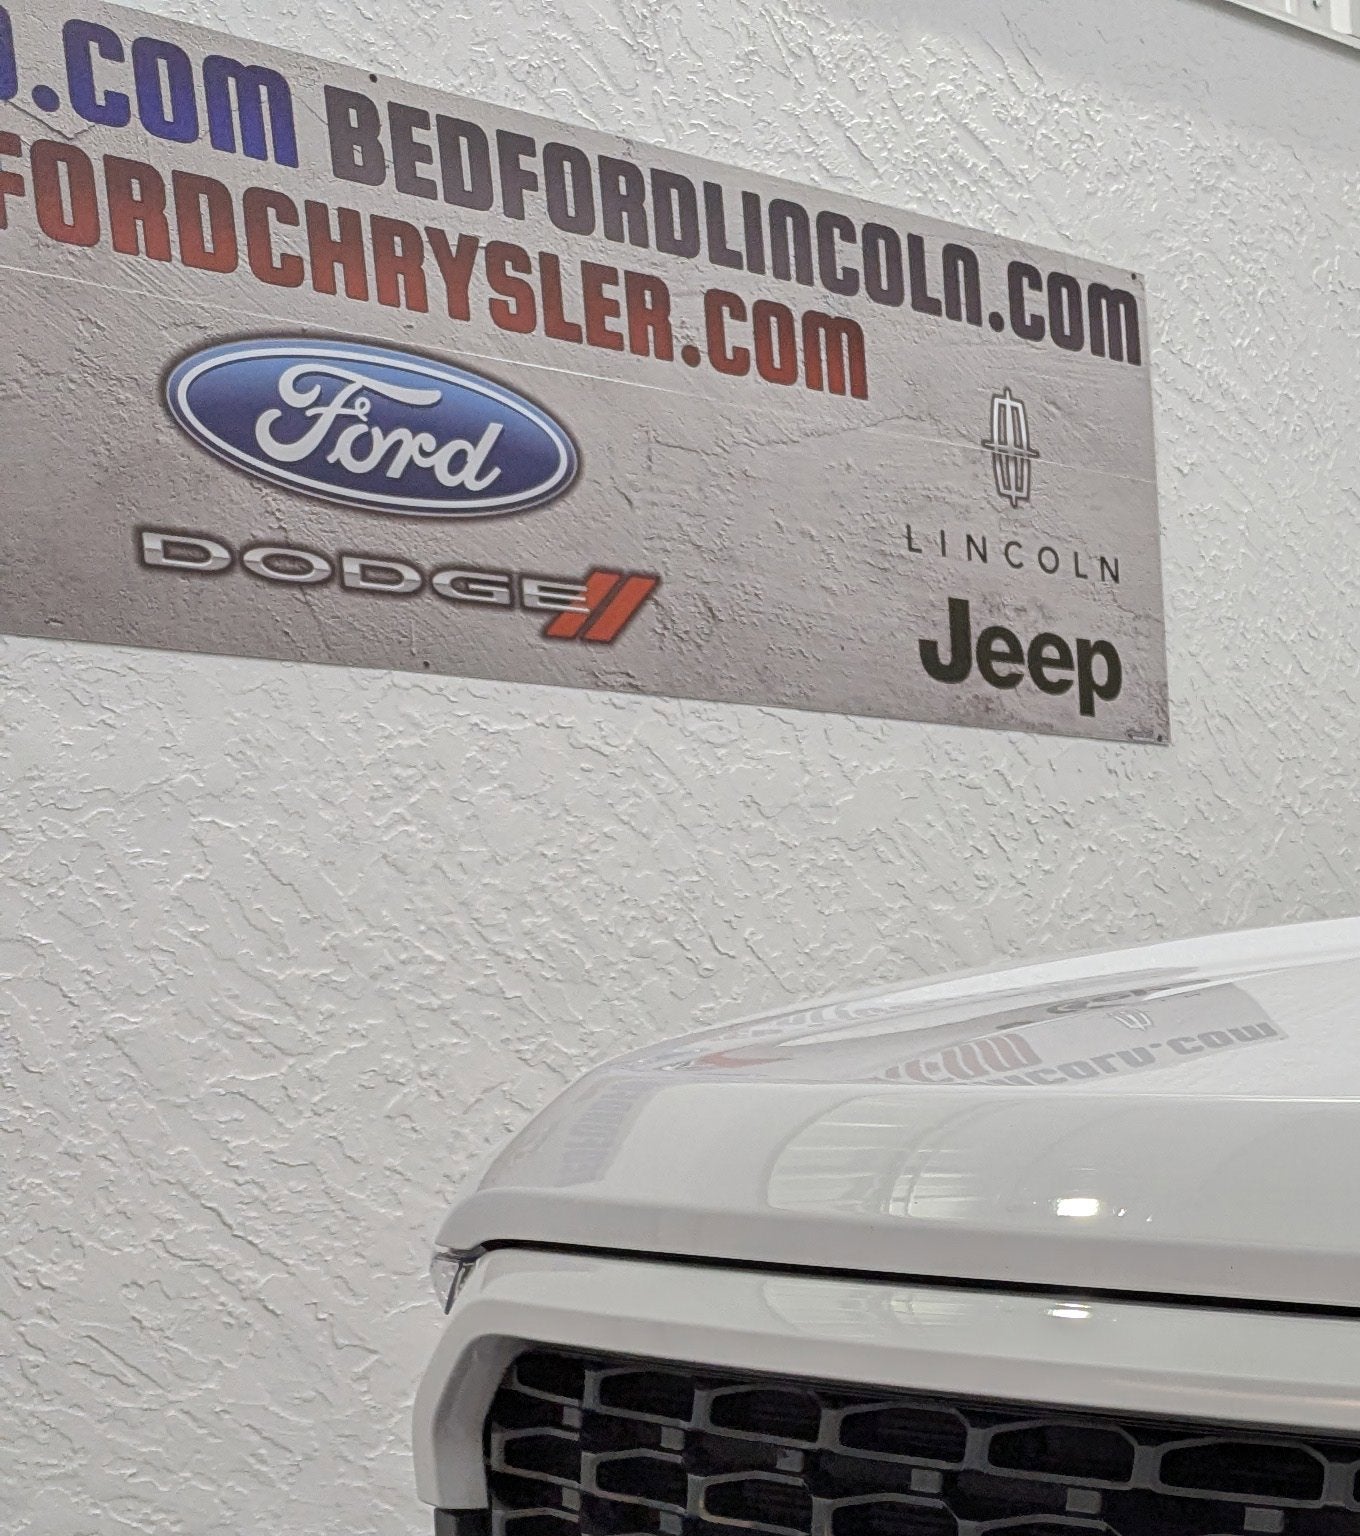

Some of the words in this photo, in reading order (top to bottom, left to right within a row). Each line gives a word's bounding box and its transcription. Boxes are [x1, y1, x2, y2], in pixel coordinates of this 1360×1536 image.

[324, 84, 1142, 367] BEDFORDLINCOLN.COM
[255, 363, 504, 491] Ford
[140, 530, 591, 615] DODGE
[905, 524, 1121, 584] LINCOLN
[918, 596, 1123, 717] Jeep
